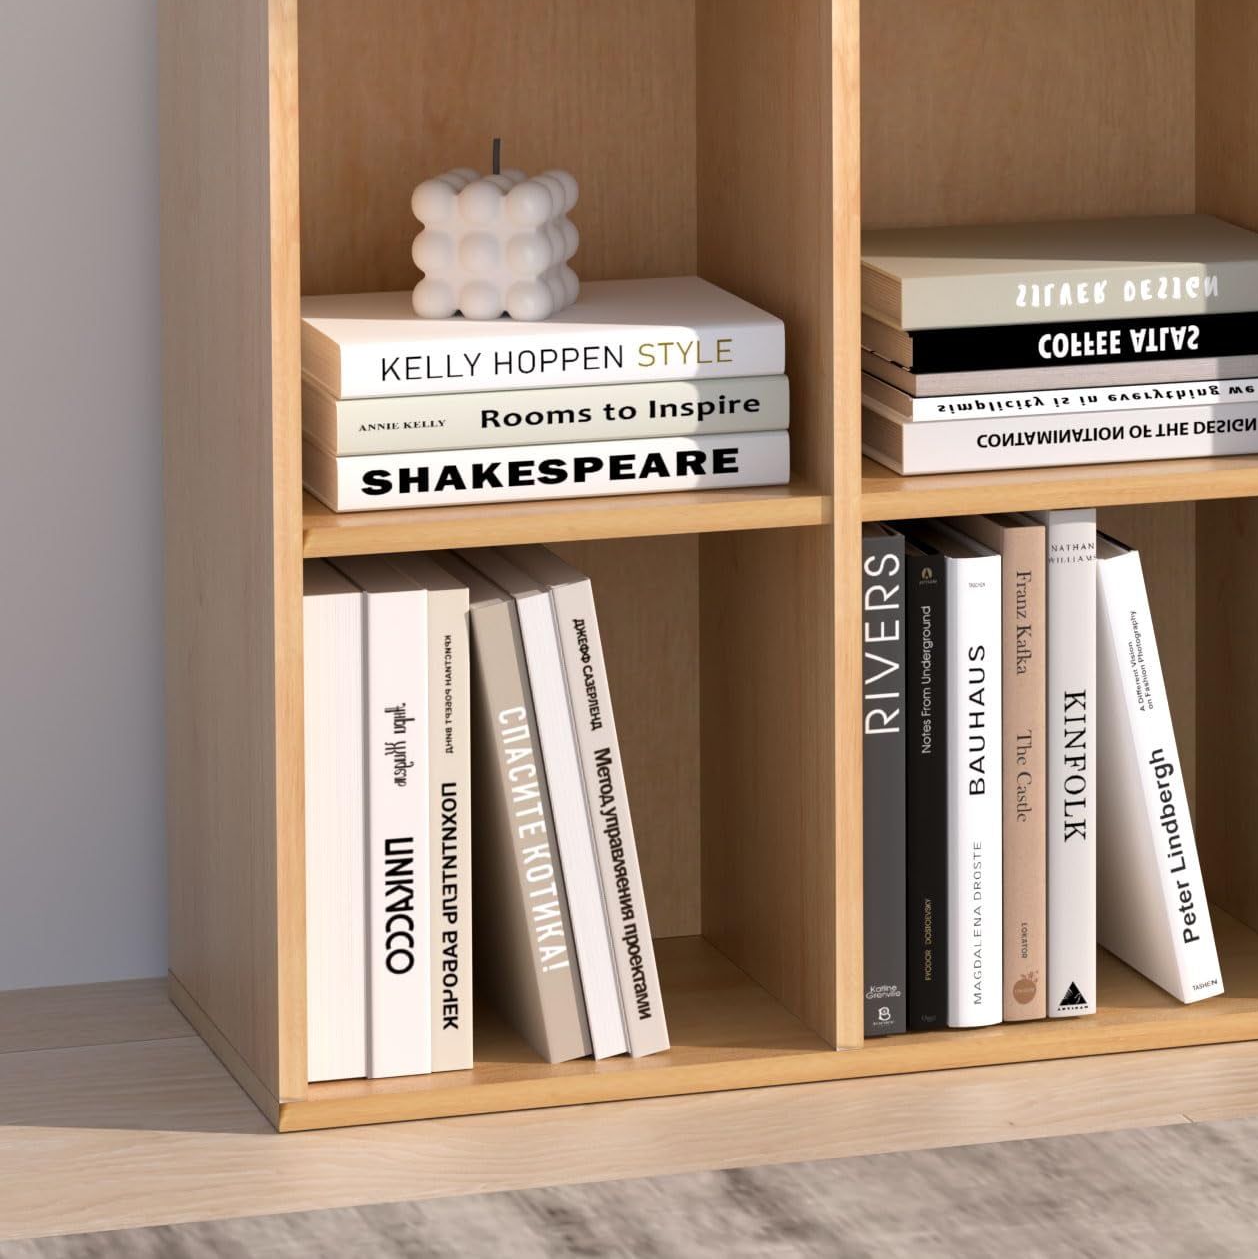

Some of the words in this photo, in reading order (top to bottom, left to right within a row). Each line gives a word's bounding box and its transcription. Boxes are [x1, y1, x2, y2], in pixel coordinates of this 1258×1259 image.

[381, 352, 481, 381] KELLY
[494, 345, 623, 374] HOPPEN
[638, 338, 733, 367] STYLE
[359, 422, 400, 431] ANNIE
[403, 419, 446, 429] KELLY
[481, 406, 592, 428] Rooms
[604, 402, 637, 421] to
[649, 394, 761, 422] Inspire
[361, 447, 740, 495] SHAKESPEARE
[1051, 542, 1095, 552] NATHAN
[1016, 570, 1033, 621] Franz
[863, 552, 900, 735] RIVERS
[921, 605, 933, 685] Underground
[1016, 625, 1033, 676] Kafka
[1128, 641, 1136, 667] Vision
[1130, 611, 1145, 663] Photography
[573, 619, 590, 663] ДЖЕФФ
[582, 664, 602, 731] САЗЕРЛЕНД
[1132, 669, 1144, 703] Different
[1141, 665, 1151, 697] Fashion
[921, 687, 932, 717] From
[969, 644, 987, 796] BAUHAUS
[1147, 699, 1154, 710] on
[921, 718, 932, 754] Notes
[1016, 729, 1033, 767] The
[499, 706, 551, 839] СПАСИТЕ
[594, 747, 615, 808] Метод
[1063, 690, 1087, 843] KINFOLK
[1016, 770, 1033, 823] Castle
[1148, 748, 1187, 874] Lindbergh
[600, 805, 635, 922] управляения
[973, 840, 983, 900] DROSTE
[521, 843, 569, 973] КОТИКА!
[1177, 880, 1200, 944] Peter
[622, 922, 652, 1020] проектами
[924, 949, 932, 981] FYODOR
[973, 906, 983, 1005] MAGDALENA
